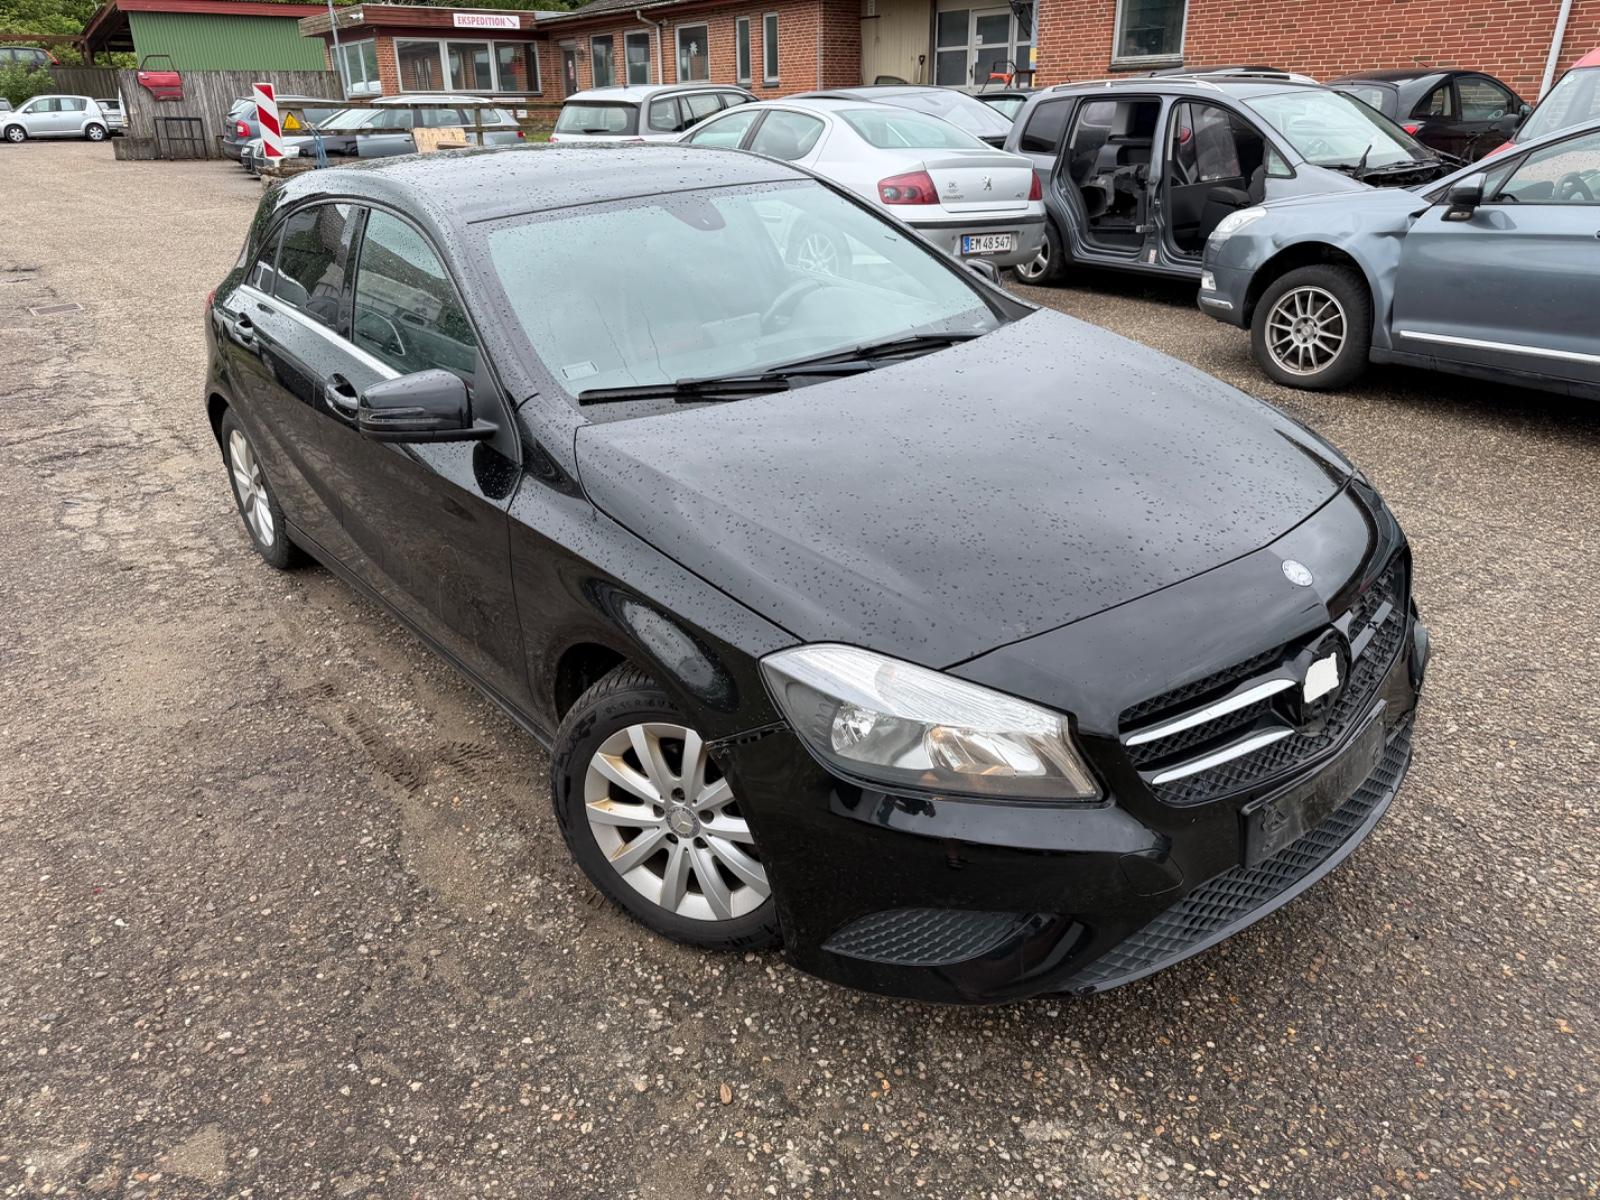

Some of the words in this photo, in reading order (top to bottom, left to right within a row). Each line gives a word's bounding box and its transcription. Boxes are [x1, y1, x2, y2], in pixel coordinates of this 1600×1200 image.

[457, 16, 505, 26] EKSPEDITION
[970, 238, 981, 251] EM
[983, 237, 993, 250] 48
[994, 236, 1010, 249] 547
